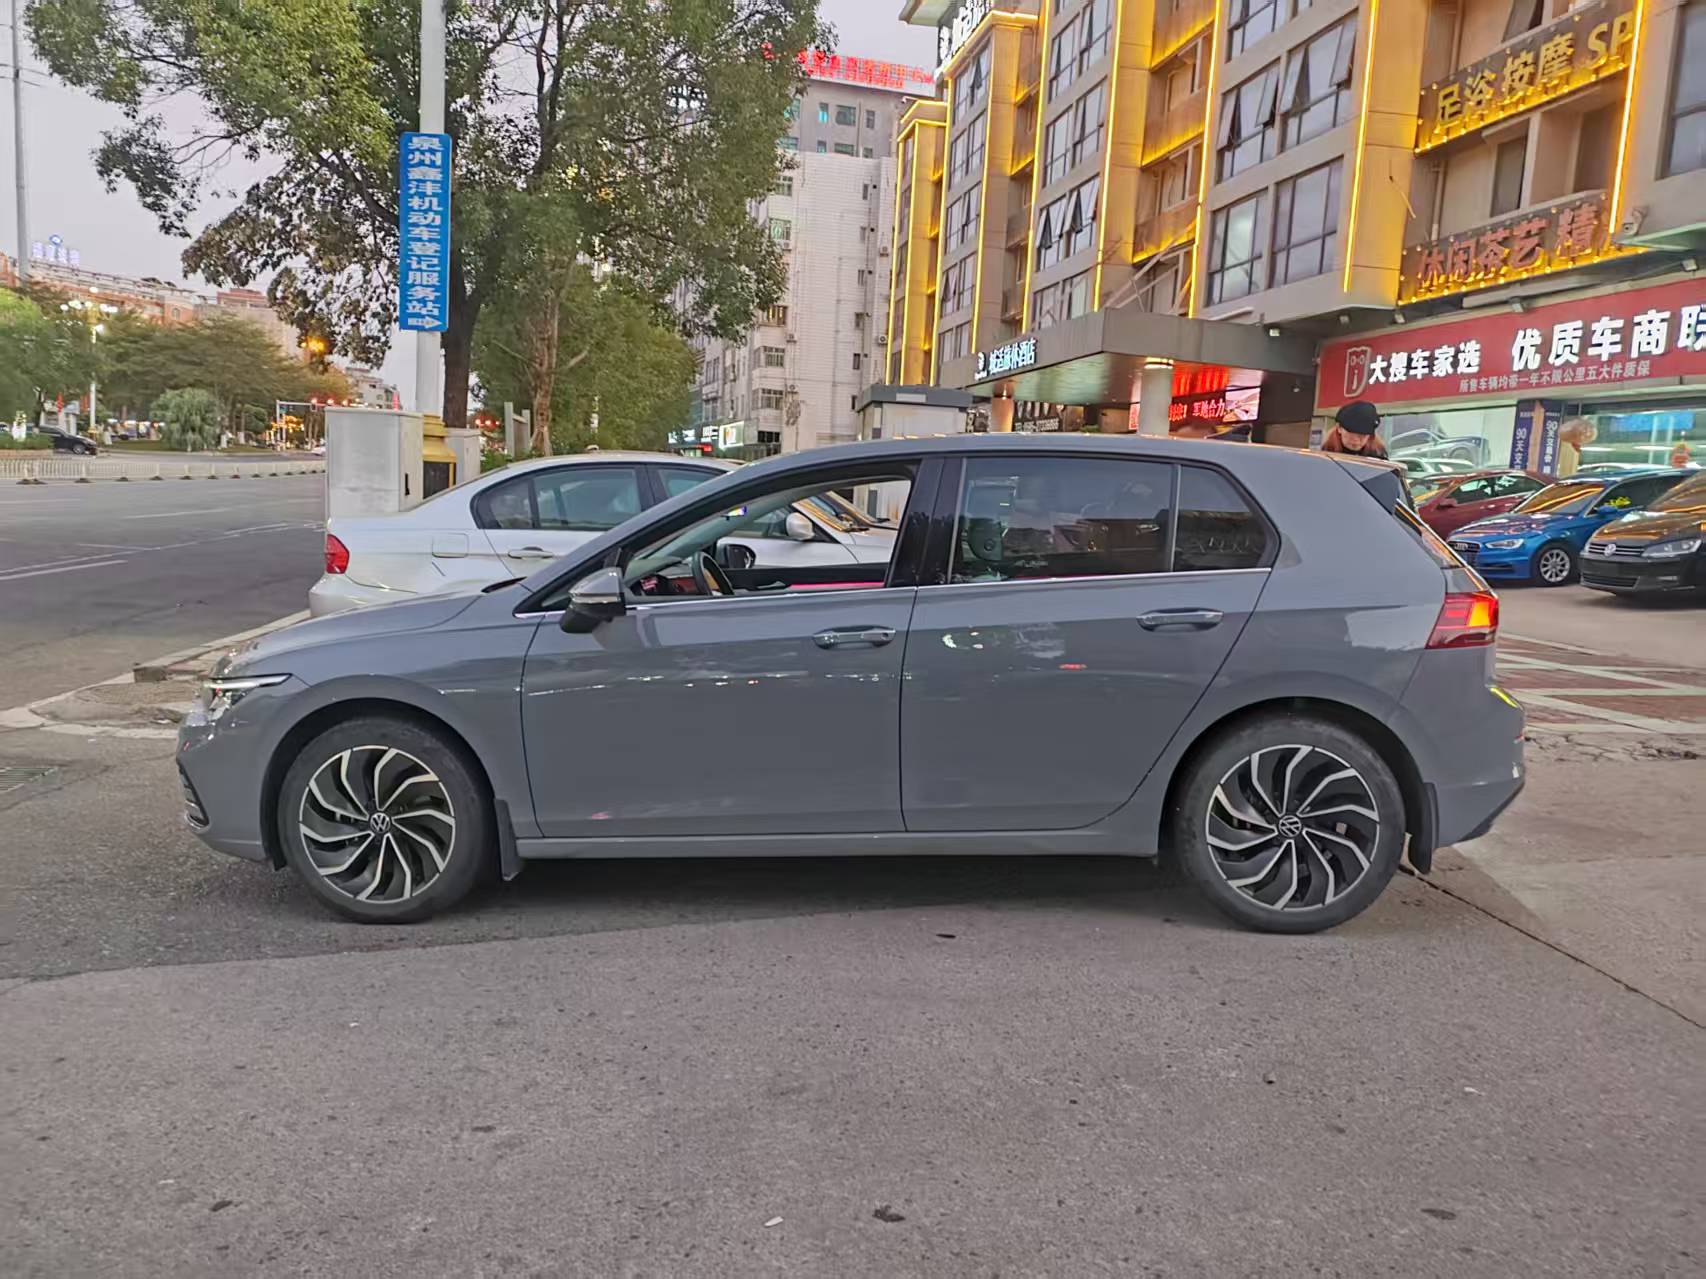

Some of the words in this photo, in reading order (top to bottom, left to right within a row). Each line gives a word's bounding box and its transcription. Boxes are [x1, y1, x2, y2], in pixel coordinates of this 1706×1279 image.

[1437, 32, 1574, 127] 足浴按摩
[1418, 217, 1551, 283] 休闲茶艺
[1368, 339, 1481, 385] 大搜车家选
[1459, 360, 1651, 393] 所售车辆均带一年不限公里五大件质保
